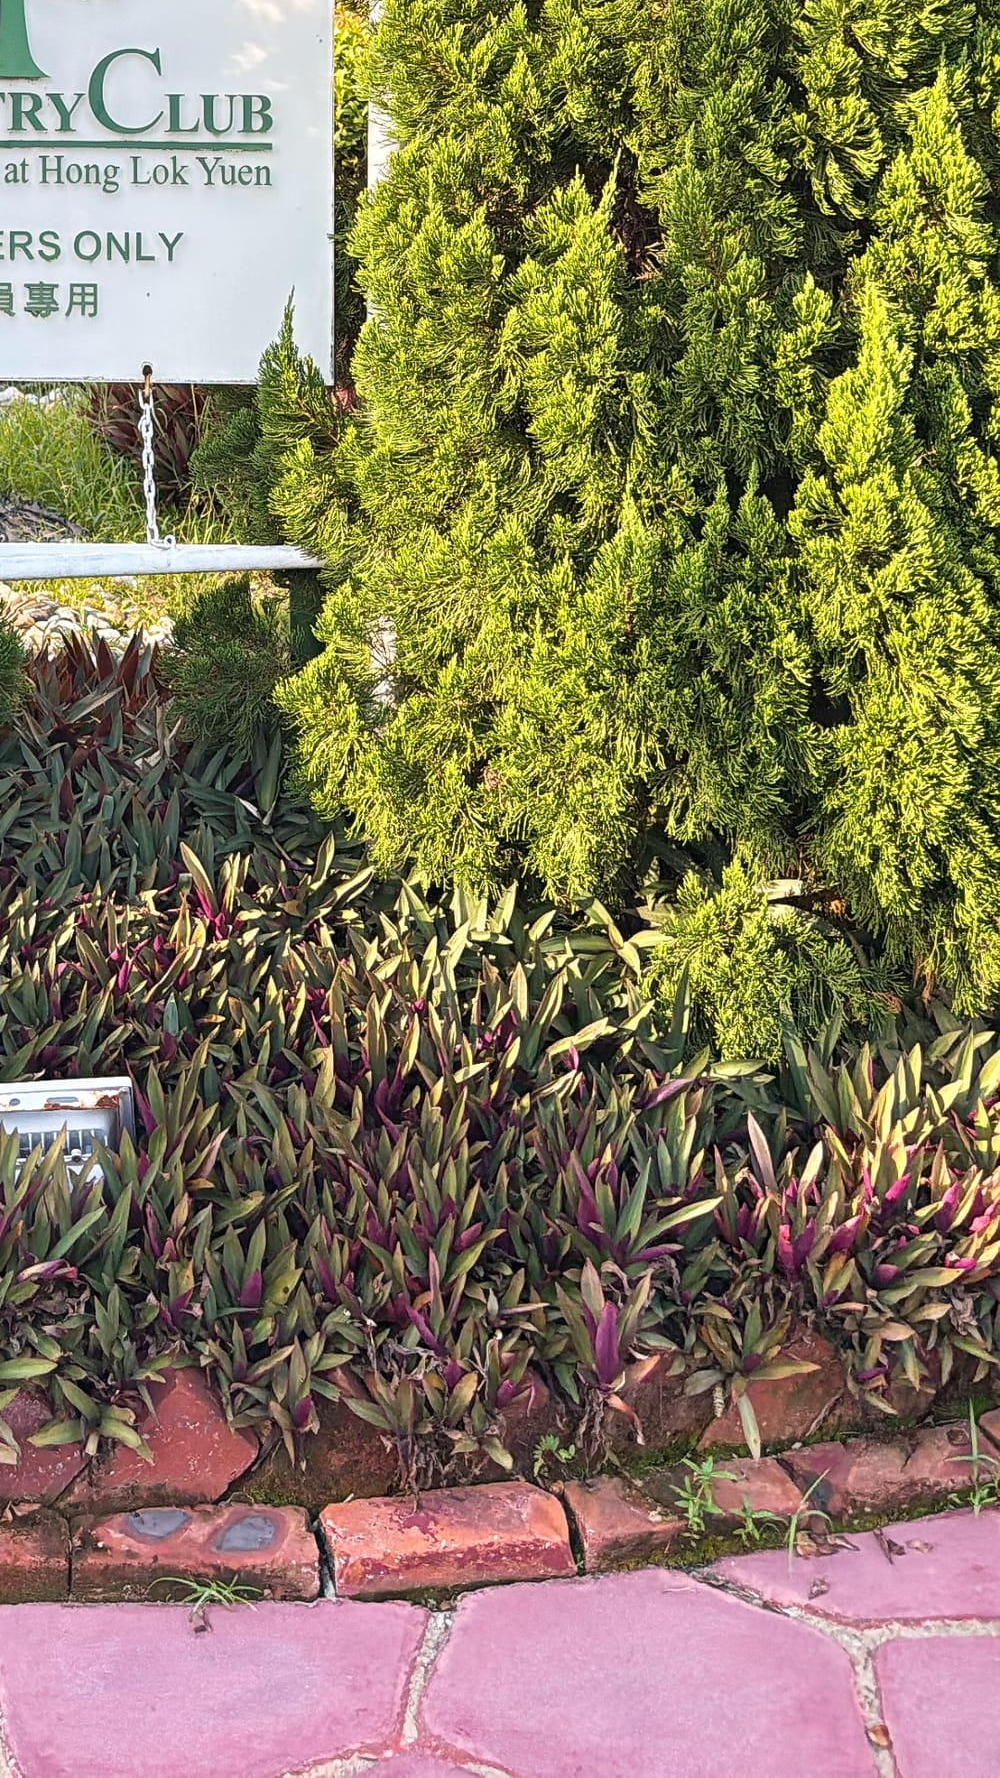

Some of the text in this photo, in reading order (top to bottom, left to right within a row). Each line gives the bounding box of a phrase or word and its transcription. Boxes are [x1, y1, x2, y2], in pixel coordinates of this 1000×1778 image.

[88, 47, 273, 135] CLUB
[4, 154, 272, 193] at Hong Lok Yuen
[73, 229, 184, 262] ONLY
